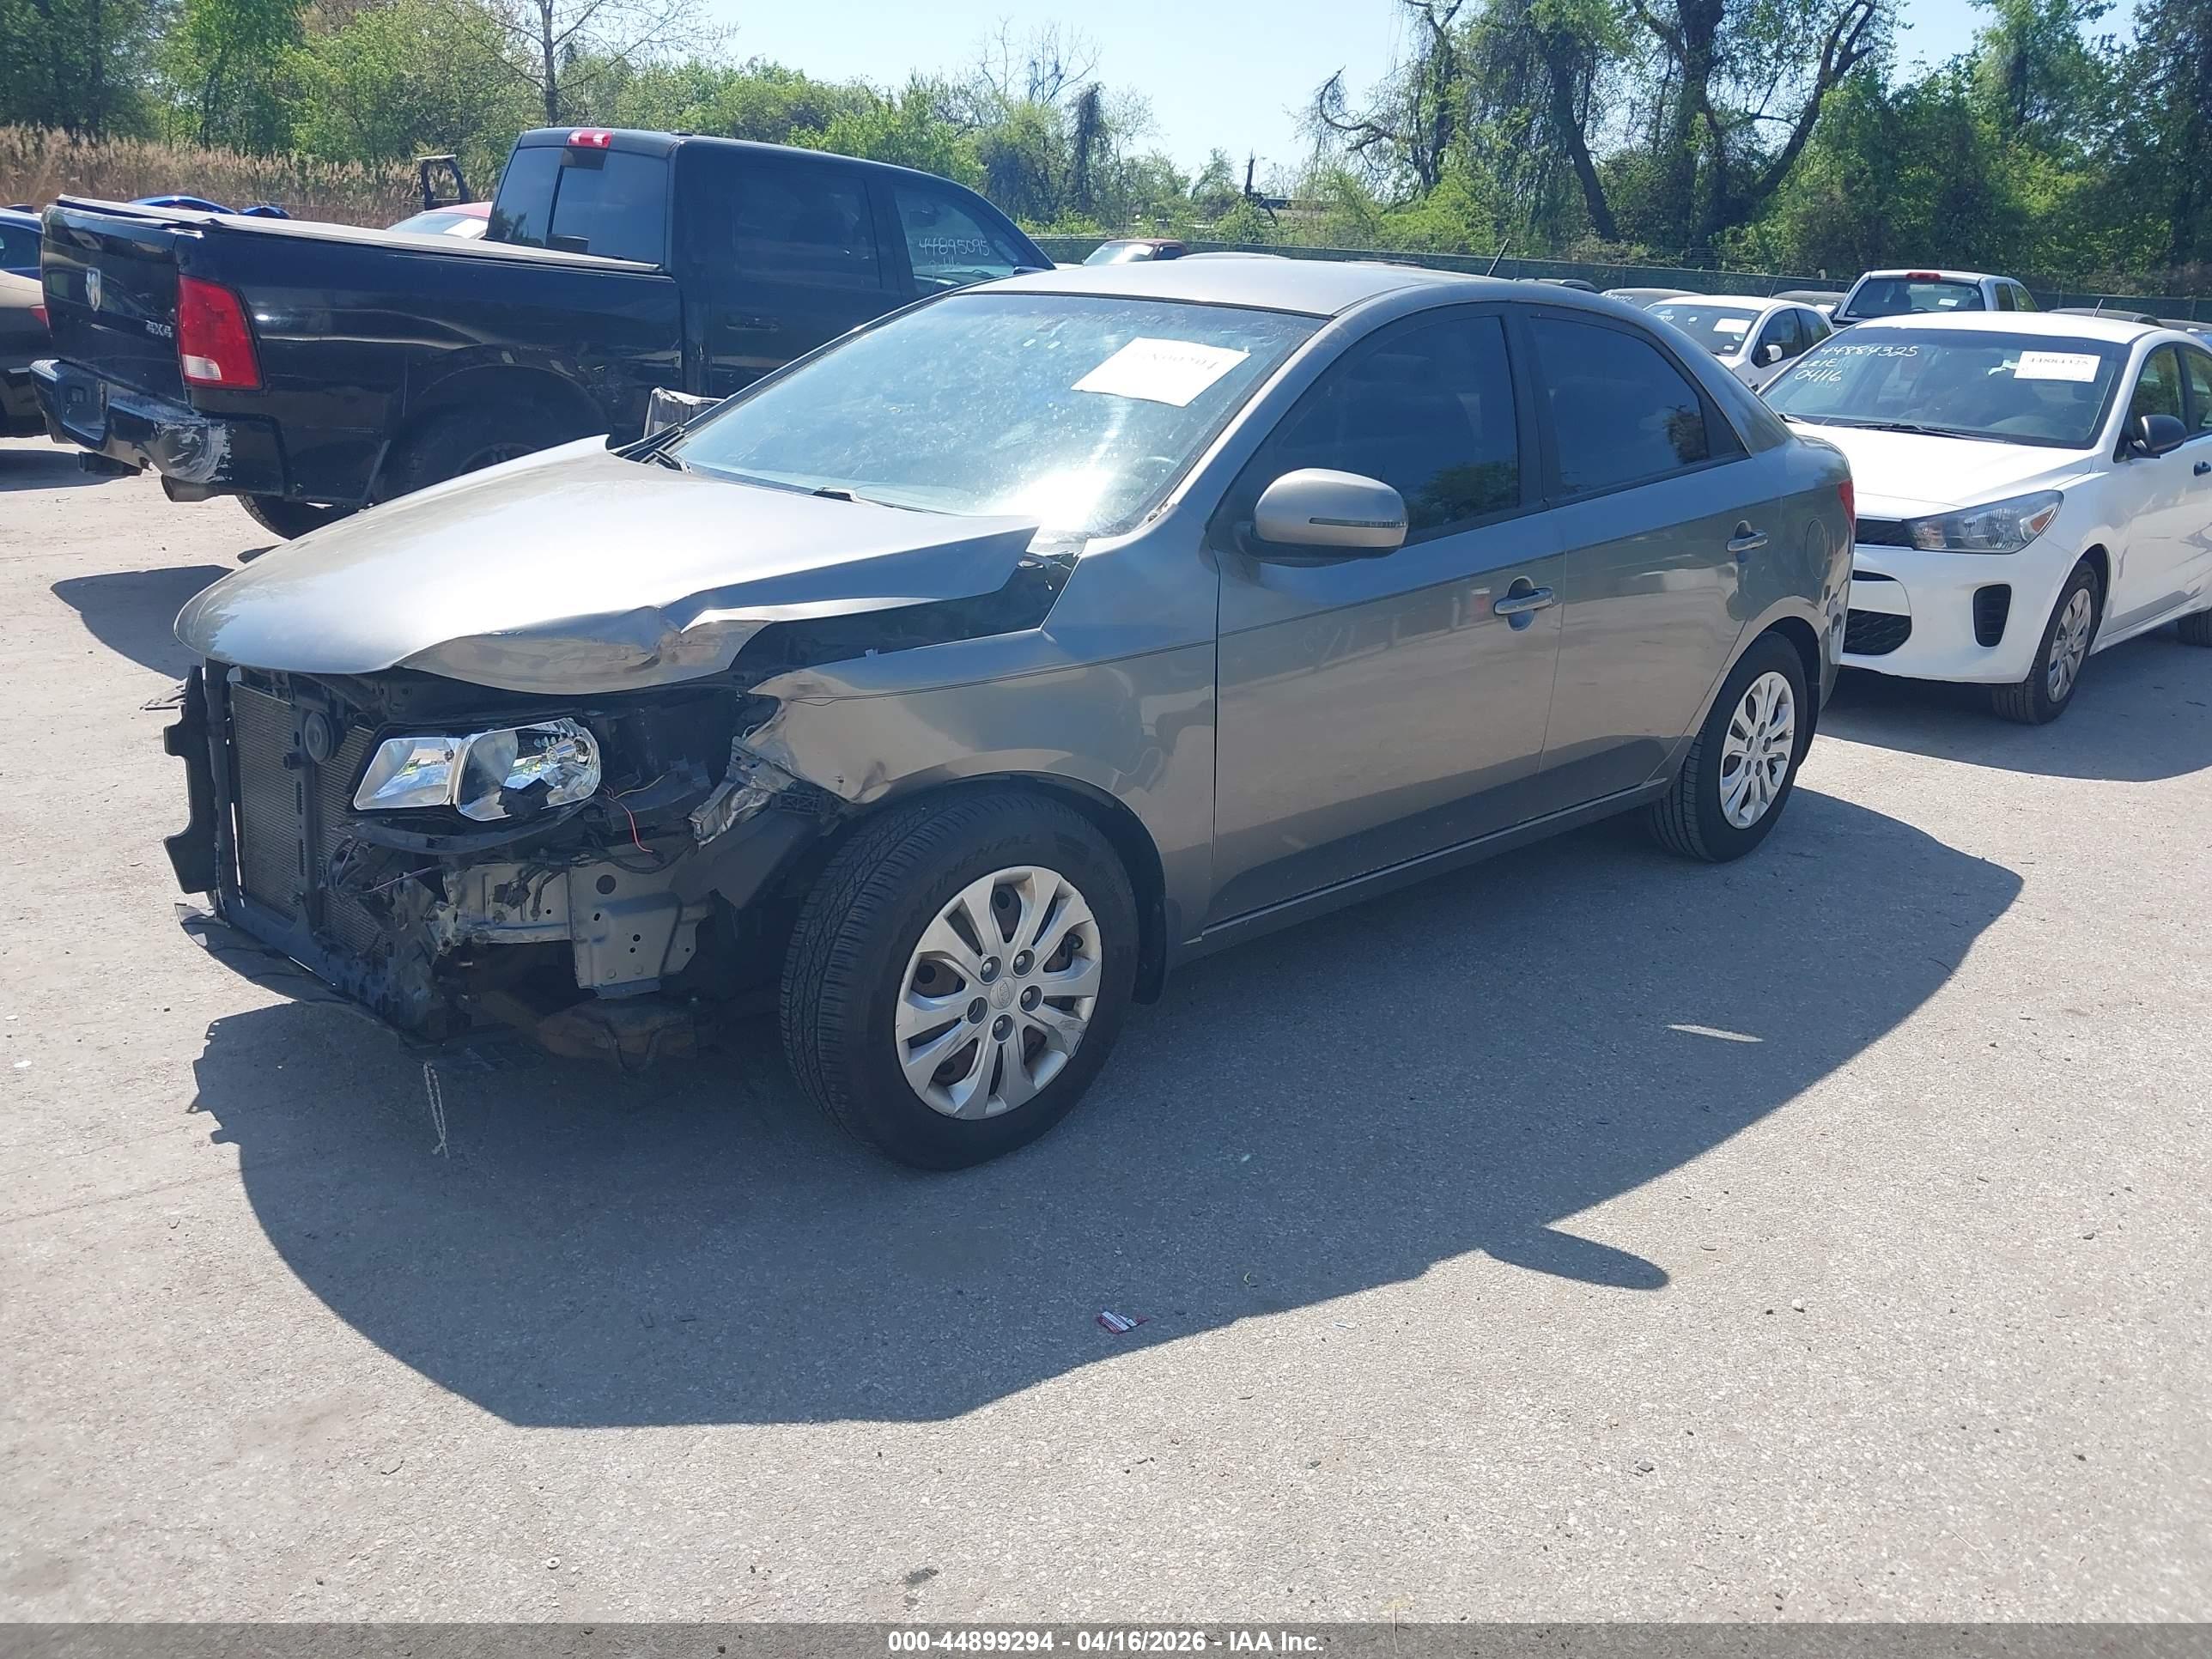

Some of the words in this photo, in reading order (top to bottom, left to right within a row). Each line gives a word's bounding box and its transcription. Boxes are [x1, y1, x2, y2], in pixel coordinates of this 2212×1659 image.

[920, 236, 990, 256] 44895095
[1820, 345, 1920, 358] 44884325
[1796, 358, 1838, 369] ERIE
[1795, 370, 1843, 384] 04/16
